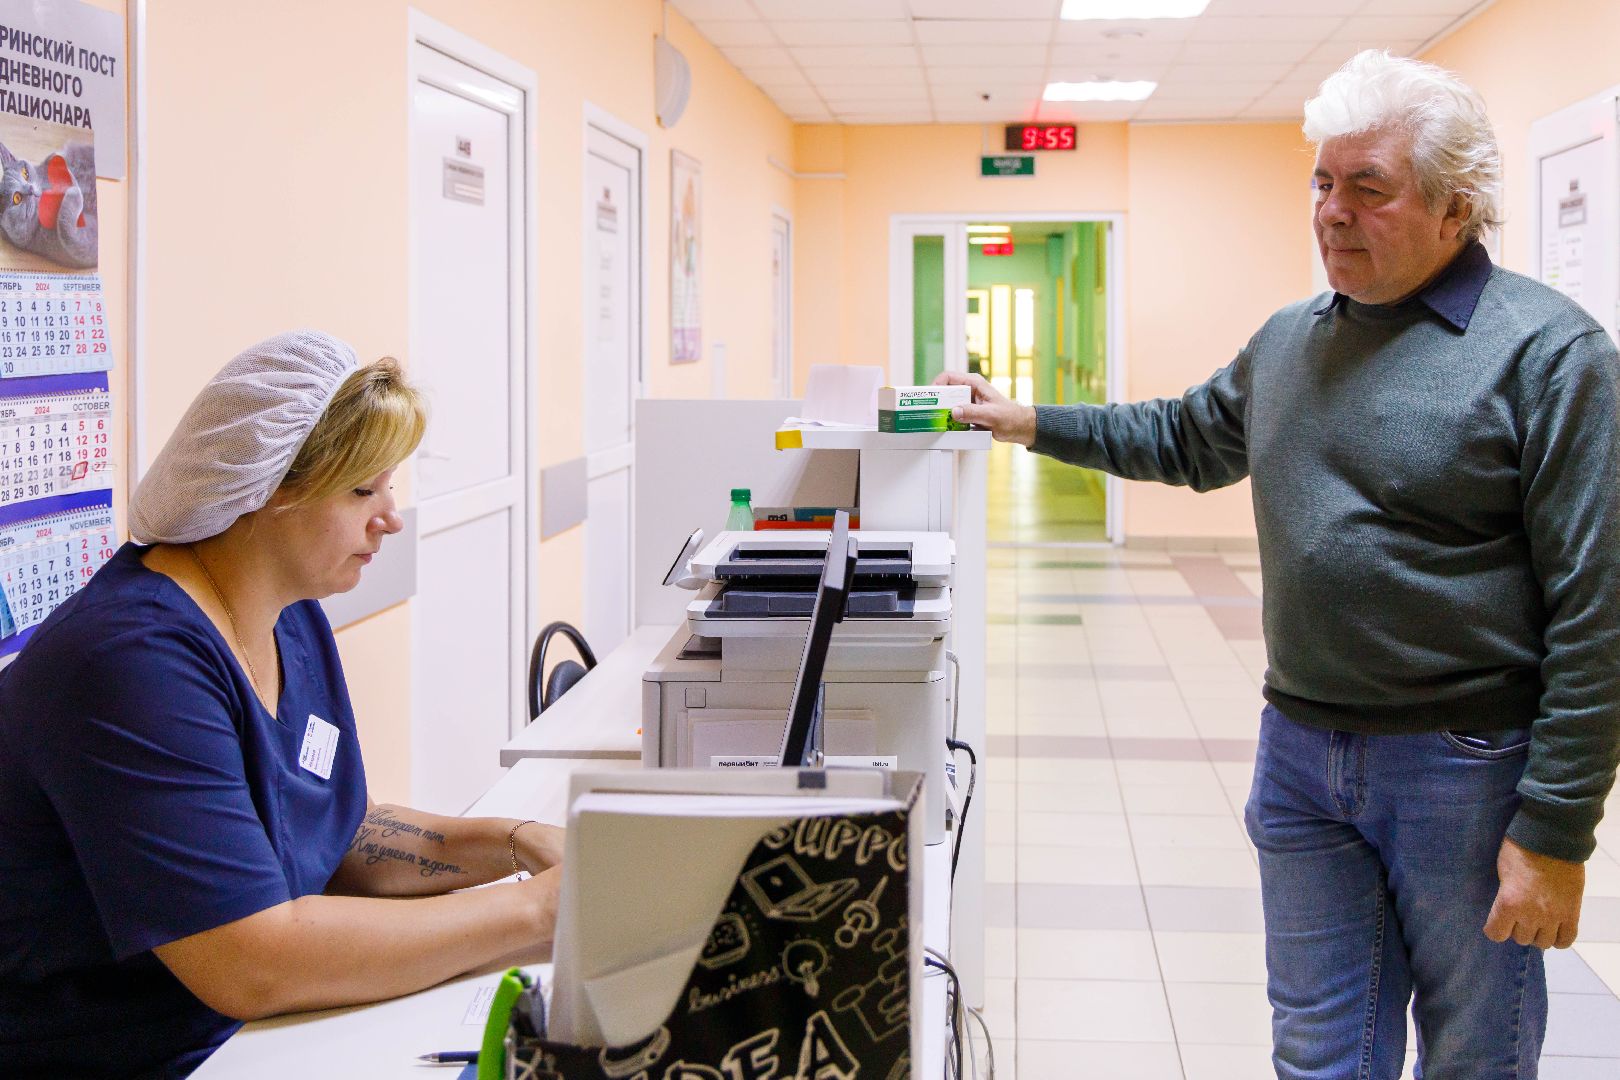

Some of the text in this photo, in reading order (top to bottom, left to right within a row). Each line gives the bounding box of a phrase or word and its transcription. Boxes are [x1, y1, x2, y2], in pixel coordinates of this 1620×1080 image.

[0, 25, 116, 77] РИНСКИЙ ПОСТ
[0, 57, 82, 97] ДНЕВНОГО
[0, 89, 92, 129] ТАЦИОНАРА
[1022, 126, 1076, 150] 9:55
[2, 301, 101, 312] 2 3 4 5 6 7 8
[3, 316, 102, 327] 9 10 11 12 13 14 15
[2, 329, 104, 342] 16 17 18 19 20 21 22
[3, 343, 106, 357] 23 24 25 26 27 28 29
[4, 362, 13, 373] 30
[35, 406, 50, 414] 2024
[73, 402, 109, 411] OCTOBER
[16, 428, 20, 437] 1
[30, 426, 35, 436] 2
[46, 424, 50, 434] 3
[61, 423, 67, 432] 4
[79, 421, 84, 431] 5
[98, 420, 104, 429] 6
[3, 434, 107, 455] 7 8 9 10 11 12 13
[1, 448, 106, 471] 14 15 16 17 18 19 20
[1, 475, 9, 486] 21
[14, 473, 23, 484] 22
[28, 470, 38, 481] 23
[44, 467, 53, 479] 24
[1, 482, 53, 501] 28 29 30 31
[36, 528, 52, 537] 2024
[70, 517, 112, 530] NOVEMBER
[66, 542, 69, 552] 1
[82, 539, 87, 549] 2
[101, 536, 107, 545] 3
[7, 549, 113, 582] 4 5 6 7 8 9 10
[8, 567, 93, 599] 11 12 13 14 15 16
[20, 598, 27, 609] 19
[32, 594, 42, 605] 20
[49, 589, 59, 600] 21
[65, 585, 75, 596] 22
[21, 613, 29, 625] 26
[33, 608, 43, 620] 27
[49, 604, 60, 612] 2
[628, 1010, 861, 1080] EA
